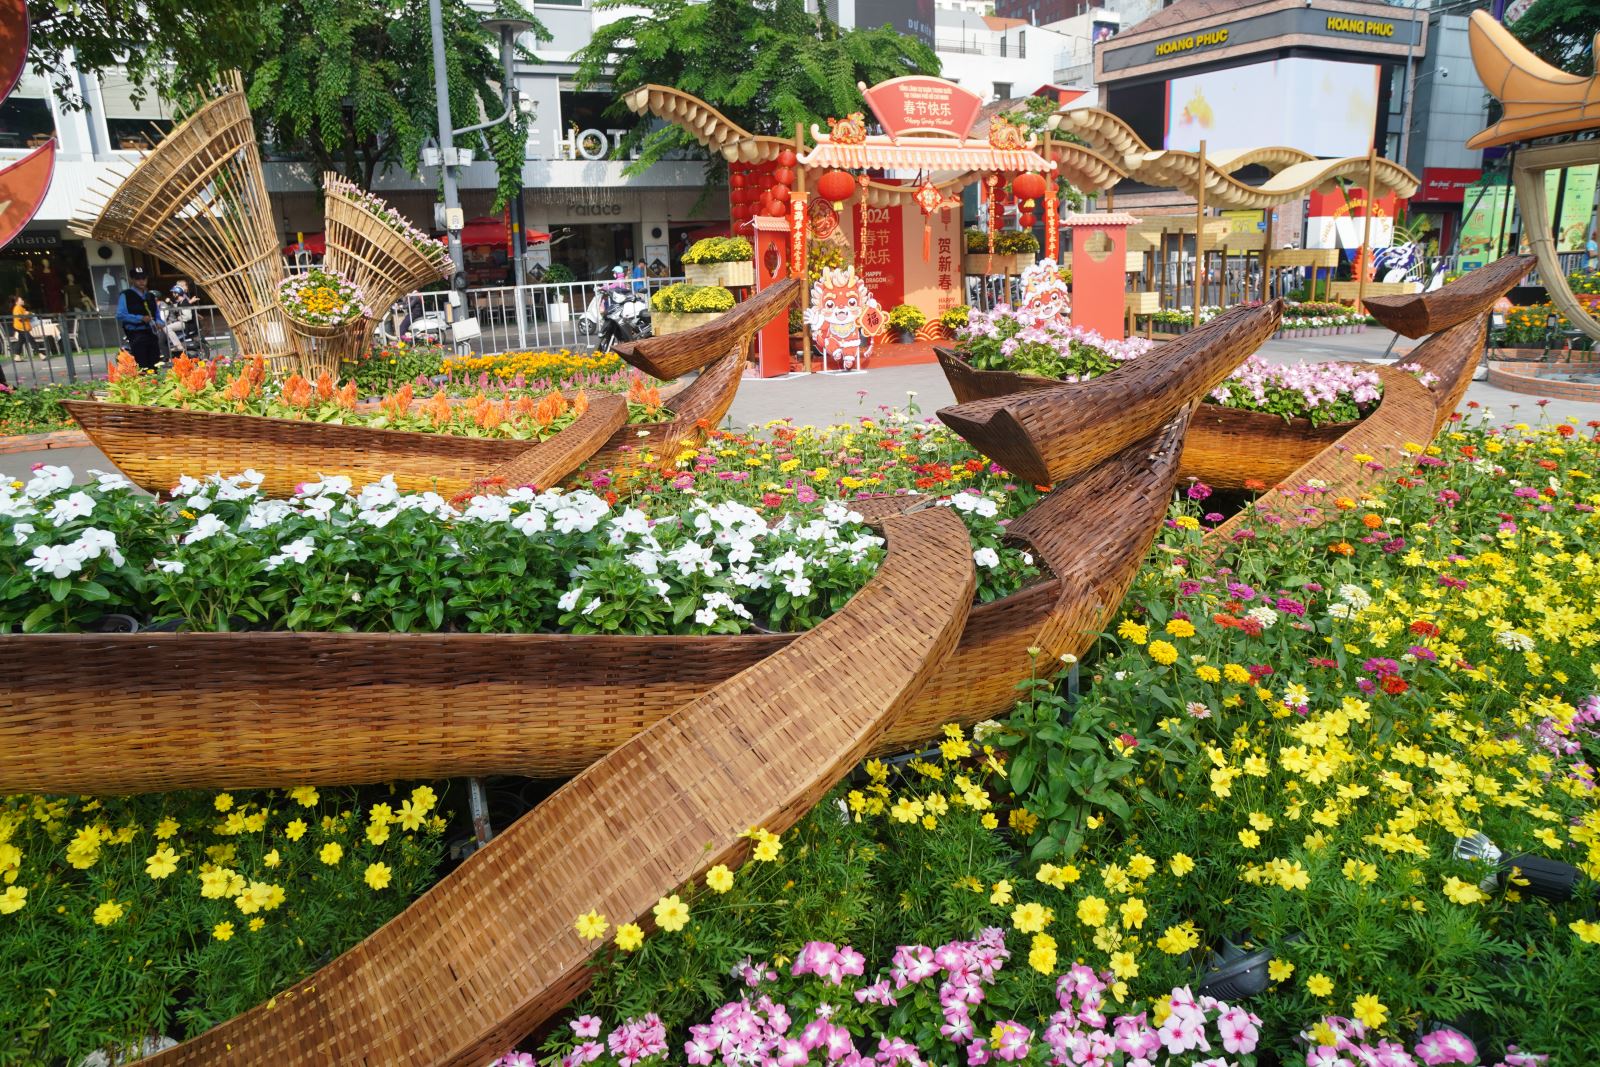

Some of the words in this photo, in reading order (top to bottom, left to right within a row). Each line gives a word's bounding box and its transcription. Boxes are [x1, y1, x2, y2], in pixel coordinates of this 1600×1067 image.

[1328, 16, 1364, 33] HOANG
[1366, 21, 1393, 36] PHUC
[1155, 37, 1194, 56] HOANG
[1196, 29, 1228, 47] PHUC
[903, 99, 952, 117] 春节快乐
[553, 128, 642, 160] HOT
[864, 248, 891, 266] 快乐
[938, 238, 952, 290] 贺新春
[867, 311, 880, 328] 福
